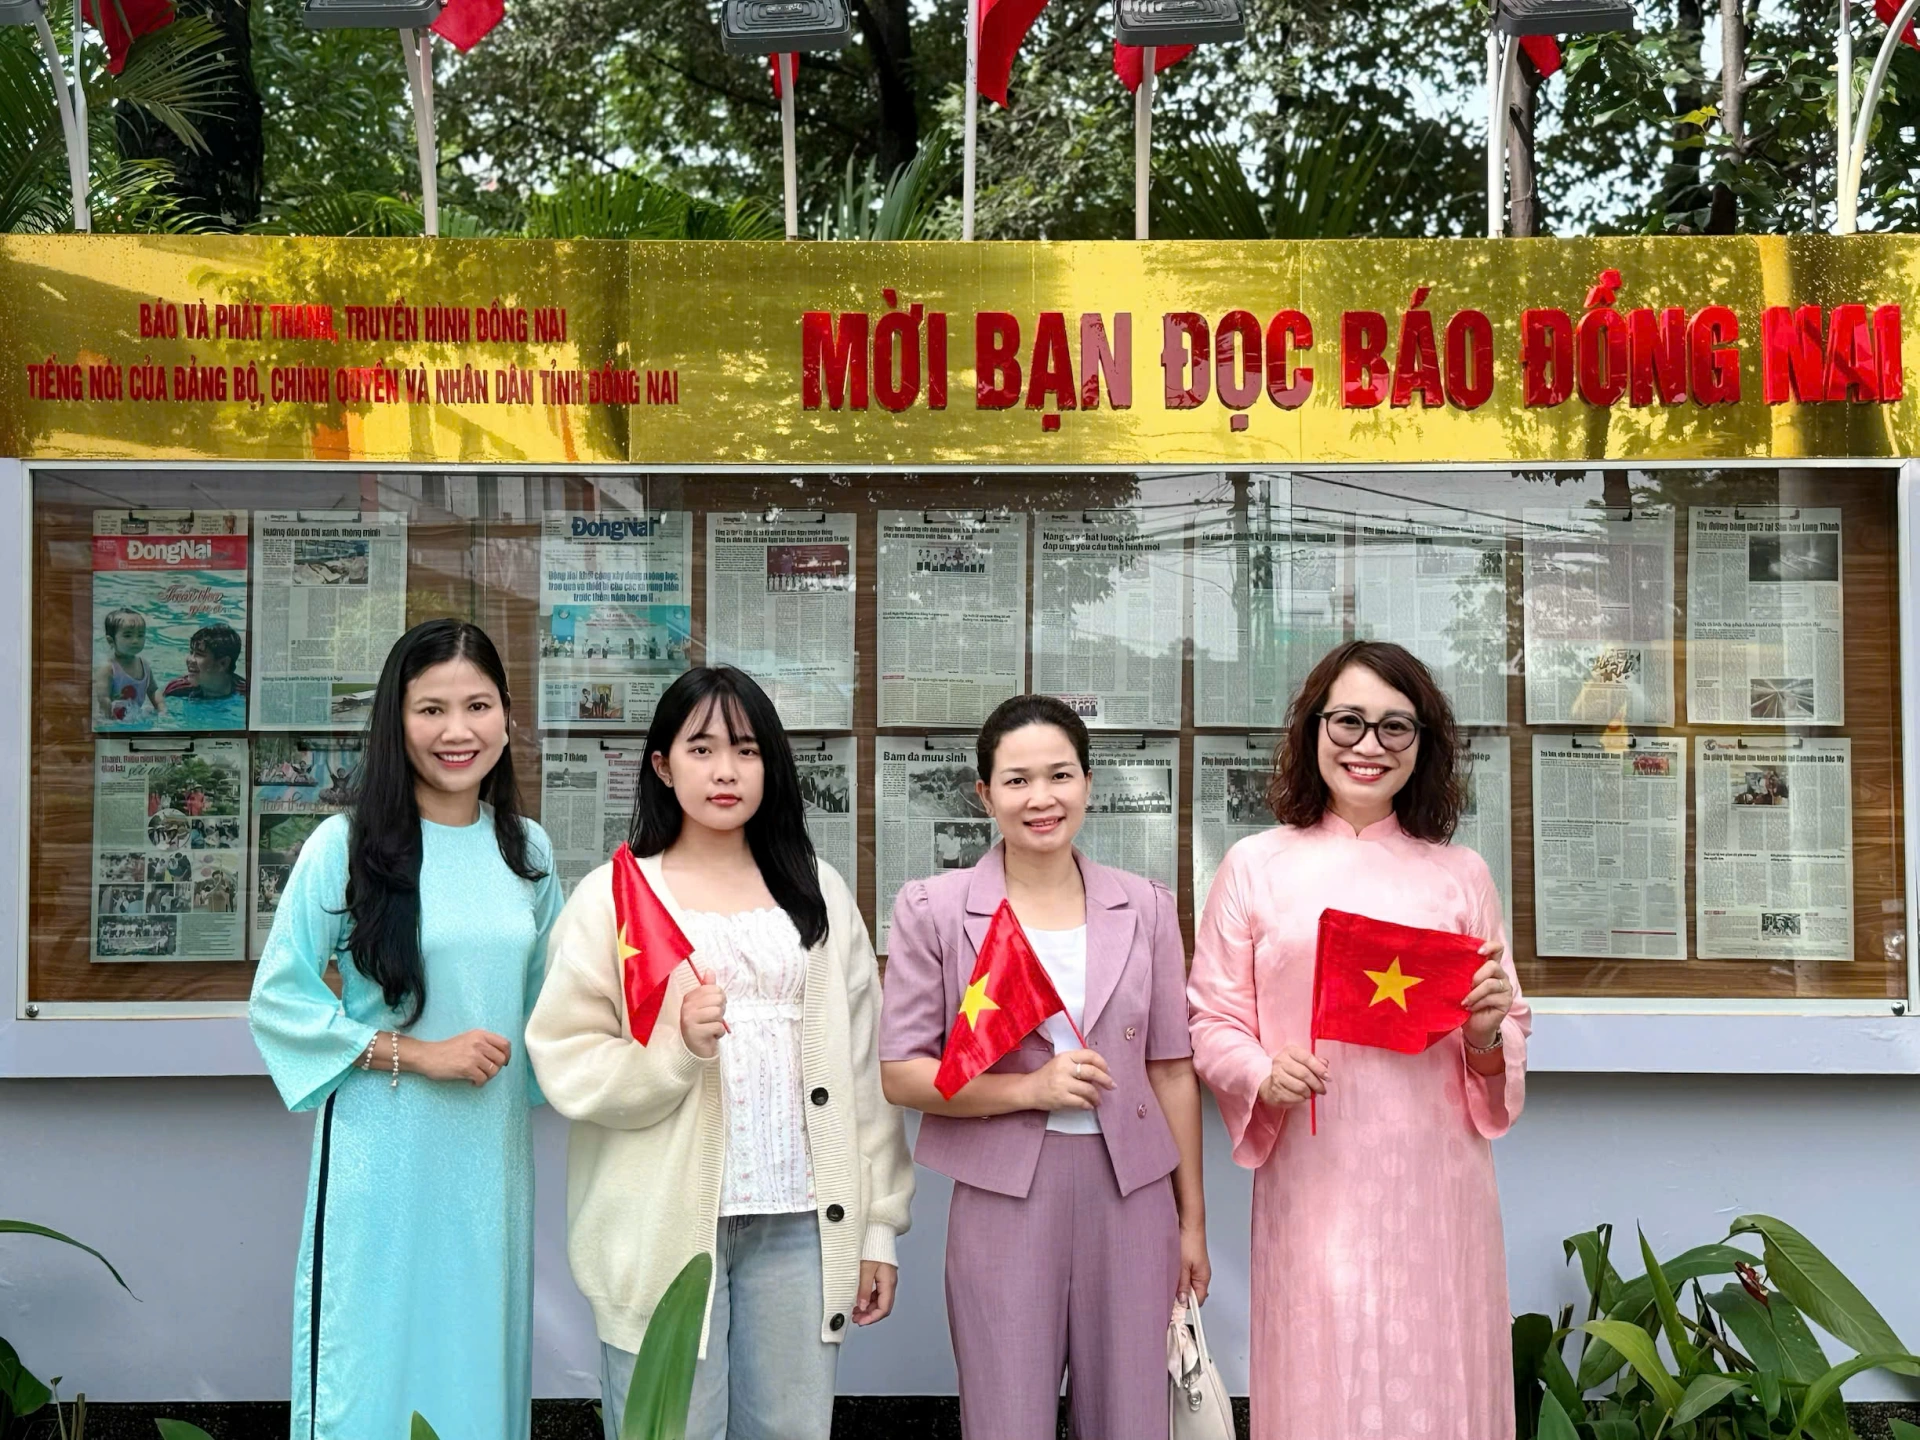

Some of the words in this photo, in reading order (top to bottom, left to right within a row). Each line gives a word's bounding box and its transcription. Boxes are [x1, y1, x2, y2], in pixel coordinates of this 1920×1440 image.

[139, 297, 178, 340] BÁO
[184, 298, 210, 340] VÀ
[215, 298, 263, 341] PHÁT
[269, 303, 338, 345] THANH,
[345, 296, 419, 342] TRUYỀN
[425, 301, 470, 344] HÌNH
[476, 297, 528, 344] ĐỒNG
[535, 308, 567, 344] NAI
[27, 352, 84, 402] TIẾNG
[90, 357, 123, 402] NÓI
[129, 354, 168, 402] CỦA
[174, 354, 227, 402] ĐẢNG
[233, 359, 265, 411] BỘ,
[271, 359, 330, 404] CHÍNH
[336, 357, 400, 408] QUYỀN
[405, 361, 430, 405] VÀ
[436, 362, 489, 406] NHÂN
[496, 362, 534, 405] DÂN
[540, 358, 584, 406] TỈNH
[589, 359, 640, 406] ĐỒNG
[647, 370, 680, 405] NAI
[803, 288, 948, 413] MỜI
[976, 311, 1133, 432] BẠN
[1161, 309, 1314, 432] ĐỌC
[1340, 286, 1494, 411] BÁO
[1762, 304, 1904, 405] NAI
